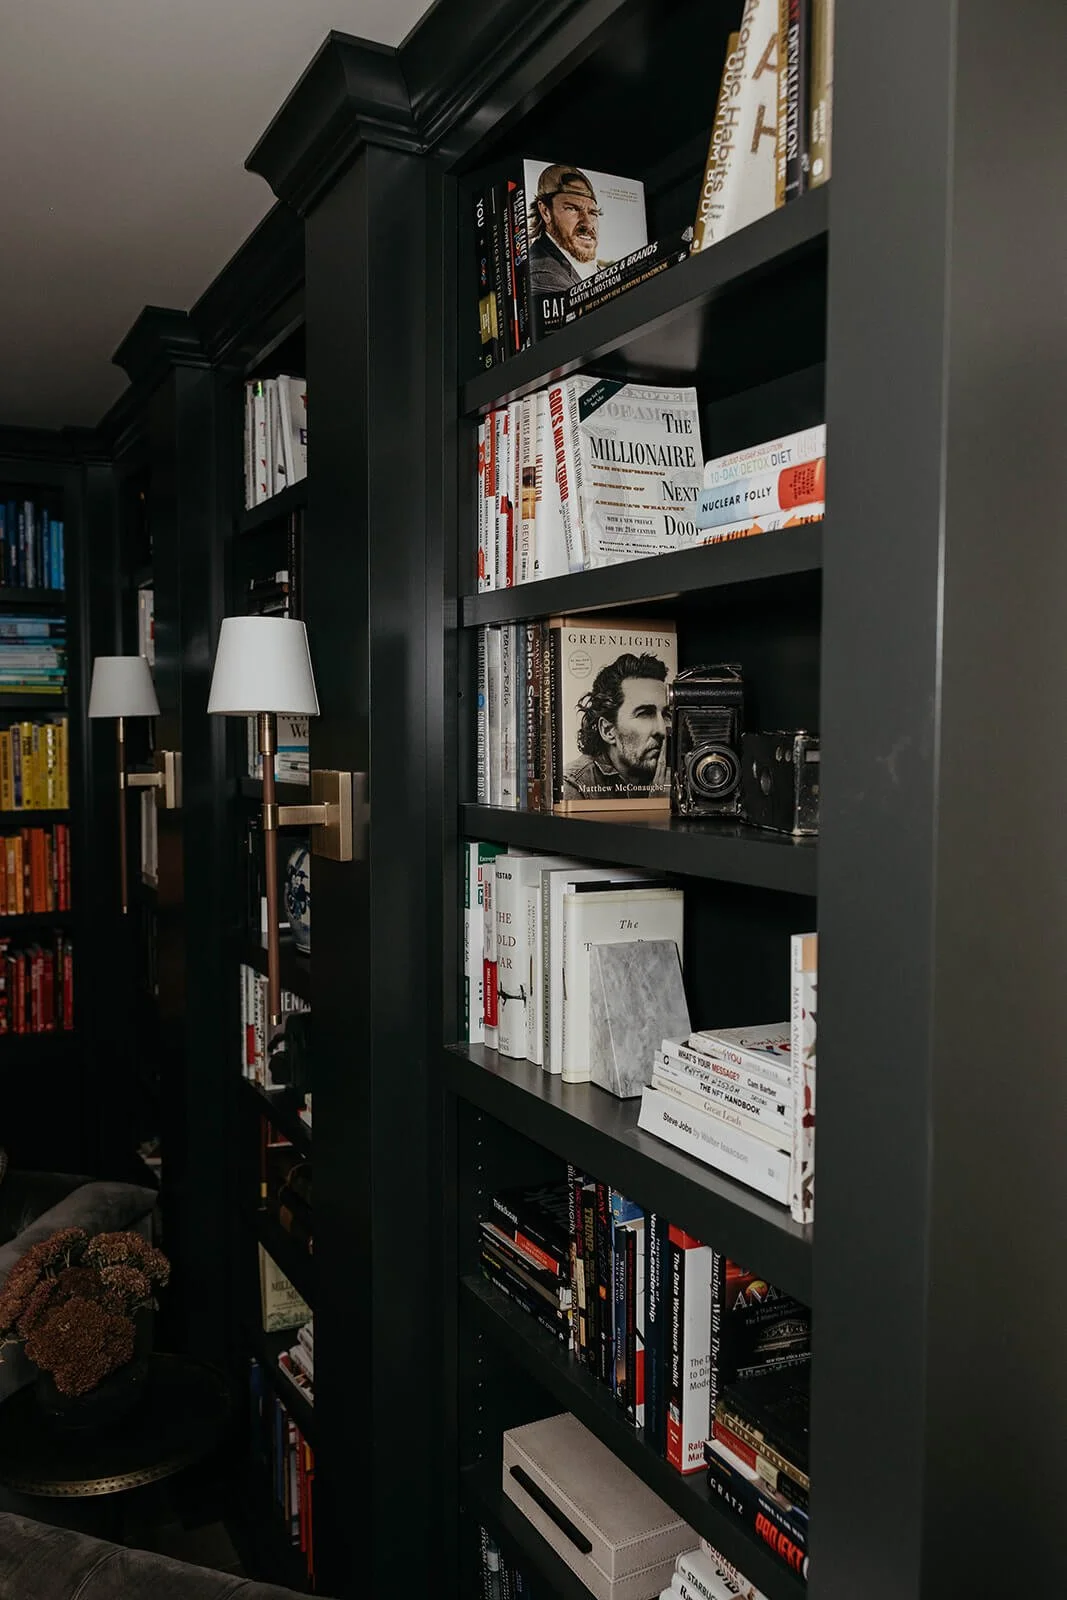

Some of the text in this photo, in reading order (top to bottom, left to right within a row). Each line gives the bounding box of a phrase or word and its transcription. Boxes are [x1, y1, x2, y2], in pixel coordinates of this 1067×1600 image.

[786, 23, 800, 162] DEVALUATION
[699, 53, 736, 225] QUANTUM BODY
[713, 105, 741, 192] Habits
[476, 198, 485, 227] YOU
[570, 281, 593, 297] CLICKS,
[594, 265, 618, 285] BRICKS
[620, 260, 627, 270] &
[627, 241, 658, 266] BRANDS
[569, 273, 622, 306] MARTIN LINDSTROM
[549, 387, 564, 428] GOD'S
[662, 413, 692, 434] THE
[522, 408, 530, 464] LIONESS ARISING
[554, 425, 564, 450] WAR
[568, 388, 584, 489] THE MILLIONAIRE NEXT DOOR
[590, 436, 696, 468] MILLIONAIRE
[556, 450, 565, 466] ON
[710, 448, 792, 484] 10-DAY DETOX DIET
[557, 464, 569, 503] TERROR
[662, 480, 700, 502] NEXT
[702, 486, 772, 512] NUCLEAR FOLLY
[568, 633, 672, 648] GREENLIGHTS
[526, 630, 535, 760] Paleo Solution
[544, 676, 550, 686] IS
[477, 645, 486, 797] CHAMBERS CONNECTING THE DOTS
[578, 784, 612, 793] Matthew
[496, 934, 516, 948] OLD
[620, 920, 640, 929] The
[792, 986, 800, 1020] MAYA
[726, 1050, 742, 1064] YOU
[792, 1024, 801, 1085] ANGELOU
[678, 1050, 697, 1064] WHAT'S
[697, 1057, 712, 1070] YOUR
[711, 1060, 740, 1080] MESSAGE?
[747, 1078, 760, 1088] Cam
[760, 1083, 776, 1096] Barber
[700, 1082, 711, 1094] THE
[712, 1087, 724, 1099] NFT
[724, 1092, 761, 1116] HANDBOOK
[704, 1102, 742, 1127] Great Leads
[662, 1112, 748, 1162] Steve Jobs by Walter Isaacson
[568, 1191, 576, 1235] VAUGHN
[584, 1207, 594, 1252] TRUMP
[672, 1300, 680, 1352] Warehouse
[710, 1302, 720, 1334] With
[690, 1356, 704, 1368] The
[710, 1336, 720, 1364] The
[672, 1353, 680, 1388] Toolkit
[690, 1368, 698, 1380] to
[688, 1441, 704, 1453] Ralp
[688, 1452, 704, 1463] Mar
[710, 1477, 744, 1516] GRATZ
[688, 1572, 718, 1600] STARBUC
